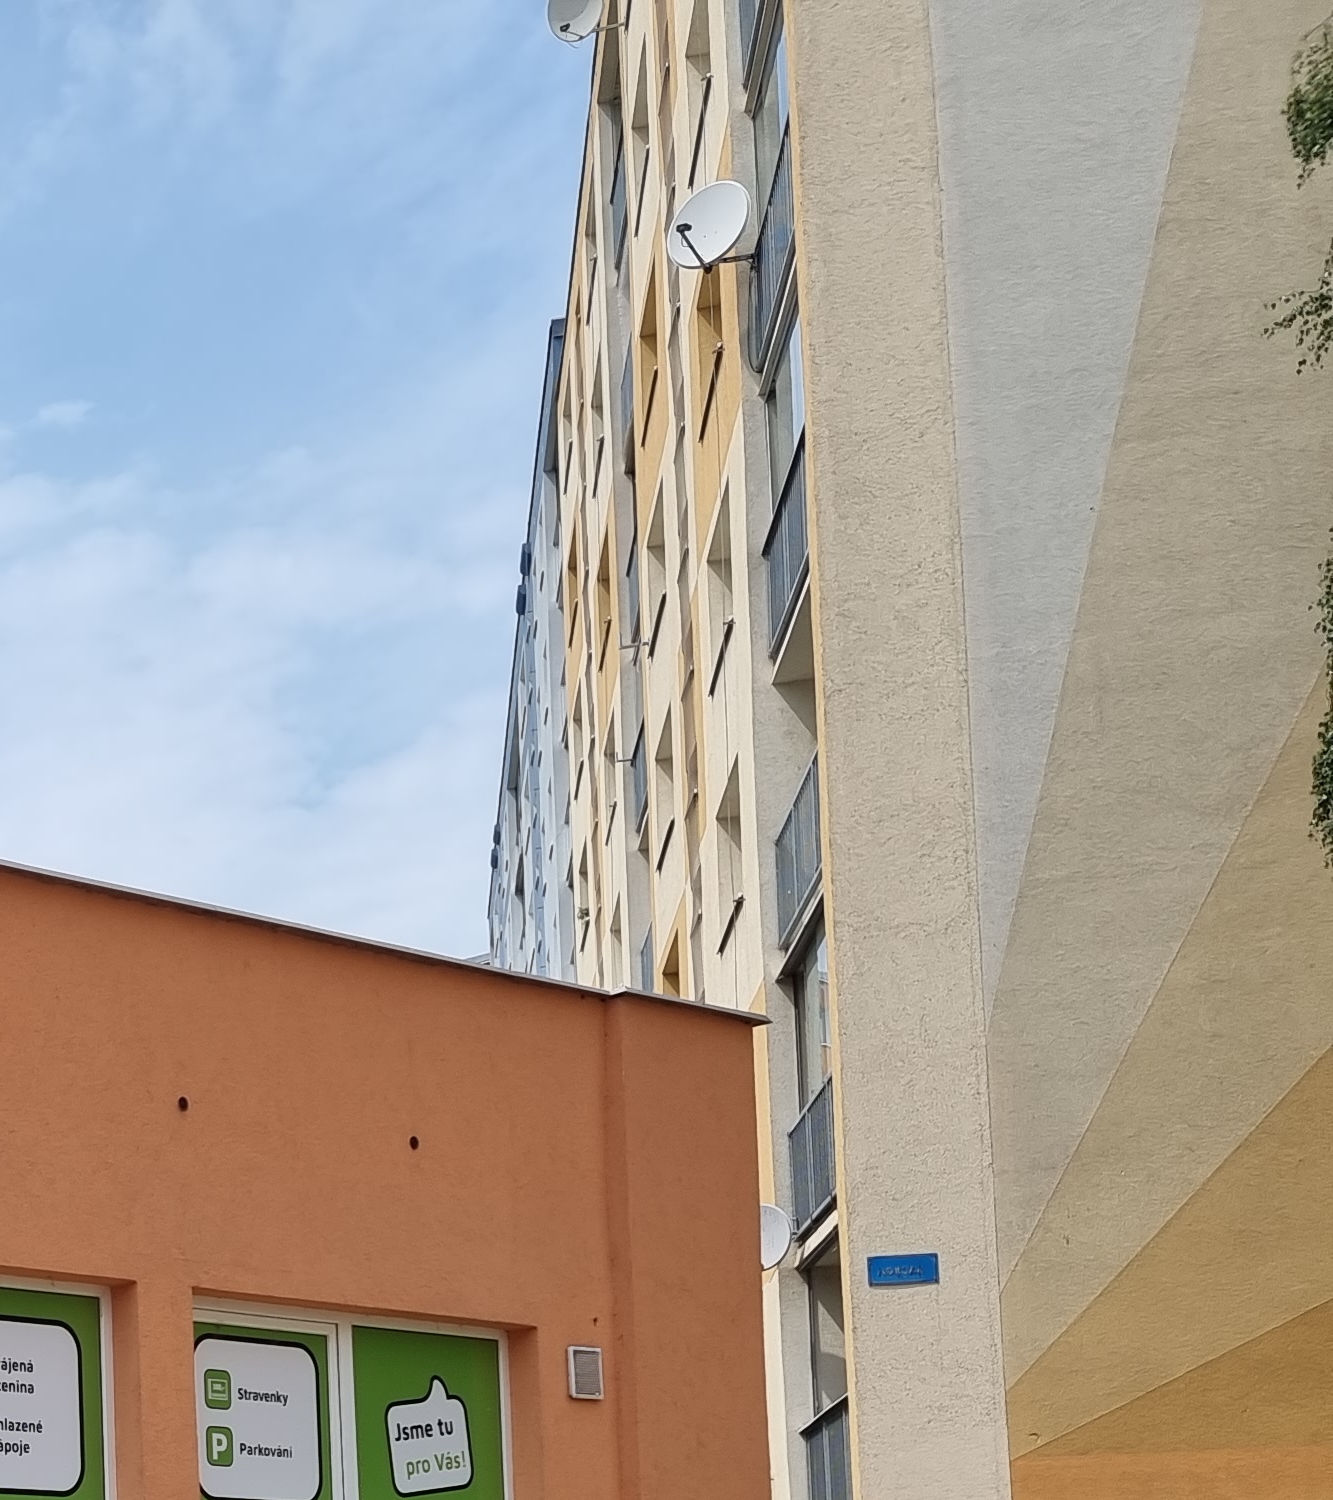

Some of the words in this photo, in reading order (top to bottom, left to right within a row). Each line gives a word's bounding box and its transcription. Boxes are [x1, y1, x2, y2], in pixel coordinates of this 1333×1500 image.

[237, 1387, 289, 1407] Stravenky
[395, 1422, 434, 1442] Jsme
[437, 1418, 454, 1436] tu
[239, 1442, 293, 1459] Parkování
[406, 1458, 431, 1480] pro
[434, 1450, 467, 1472] Vás!
